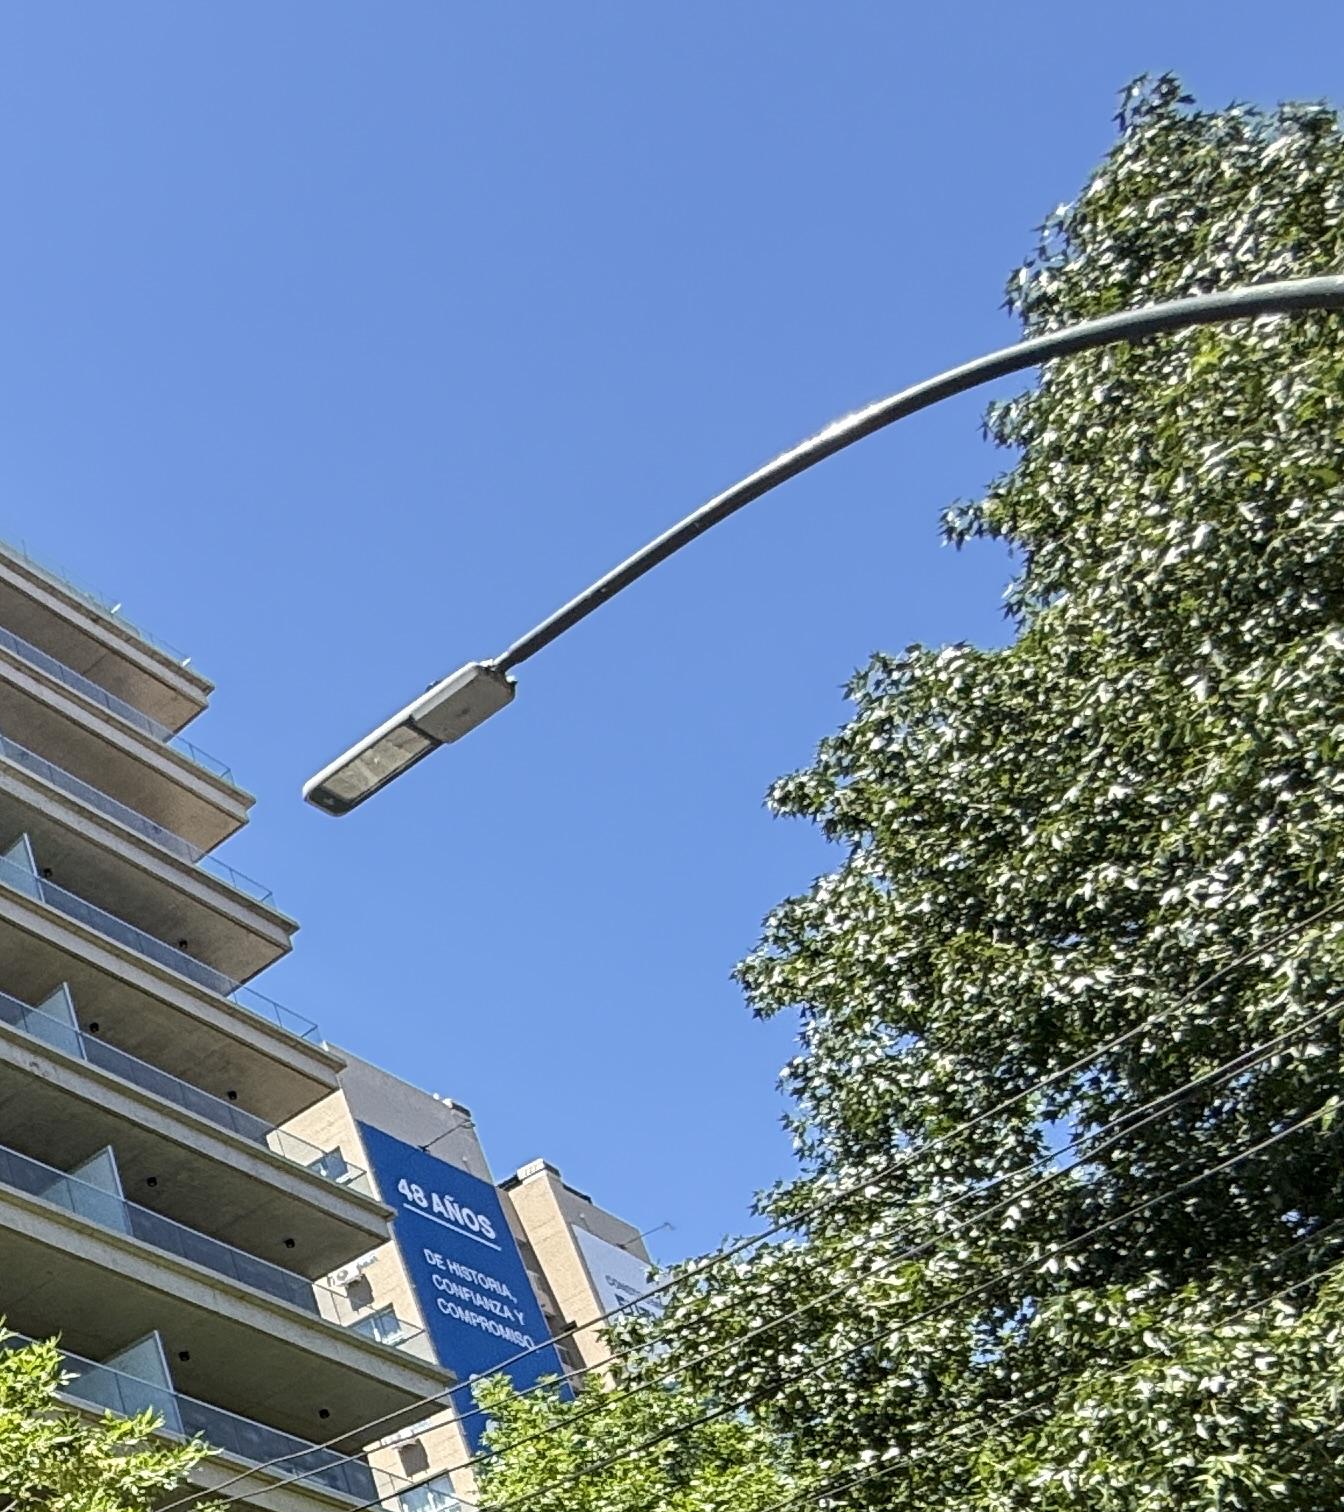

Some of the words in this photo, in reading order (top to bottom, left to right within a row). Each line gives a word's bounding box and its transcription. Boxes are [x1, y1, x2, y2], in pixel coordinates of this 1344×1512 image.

[398, 1178, 428, 1208] 48
[432, 1192, 496, 1240] AÑOS
[423, 1248, 447, 1271] DE
[446, 1258, 518, 1304] HISTORIA,
[432, 1274, 515, 1321] CONFIANZA
[513, 1309, 526, 1326] Y
